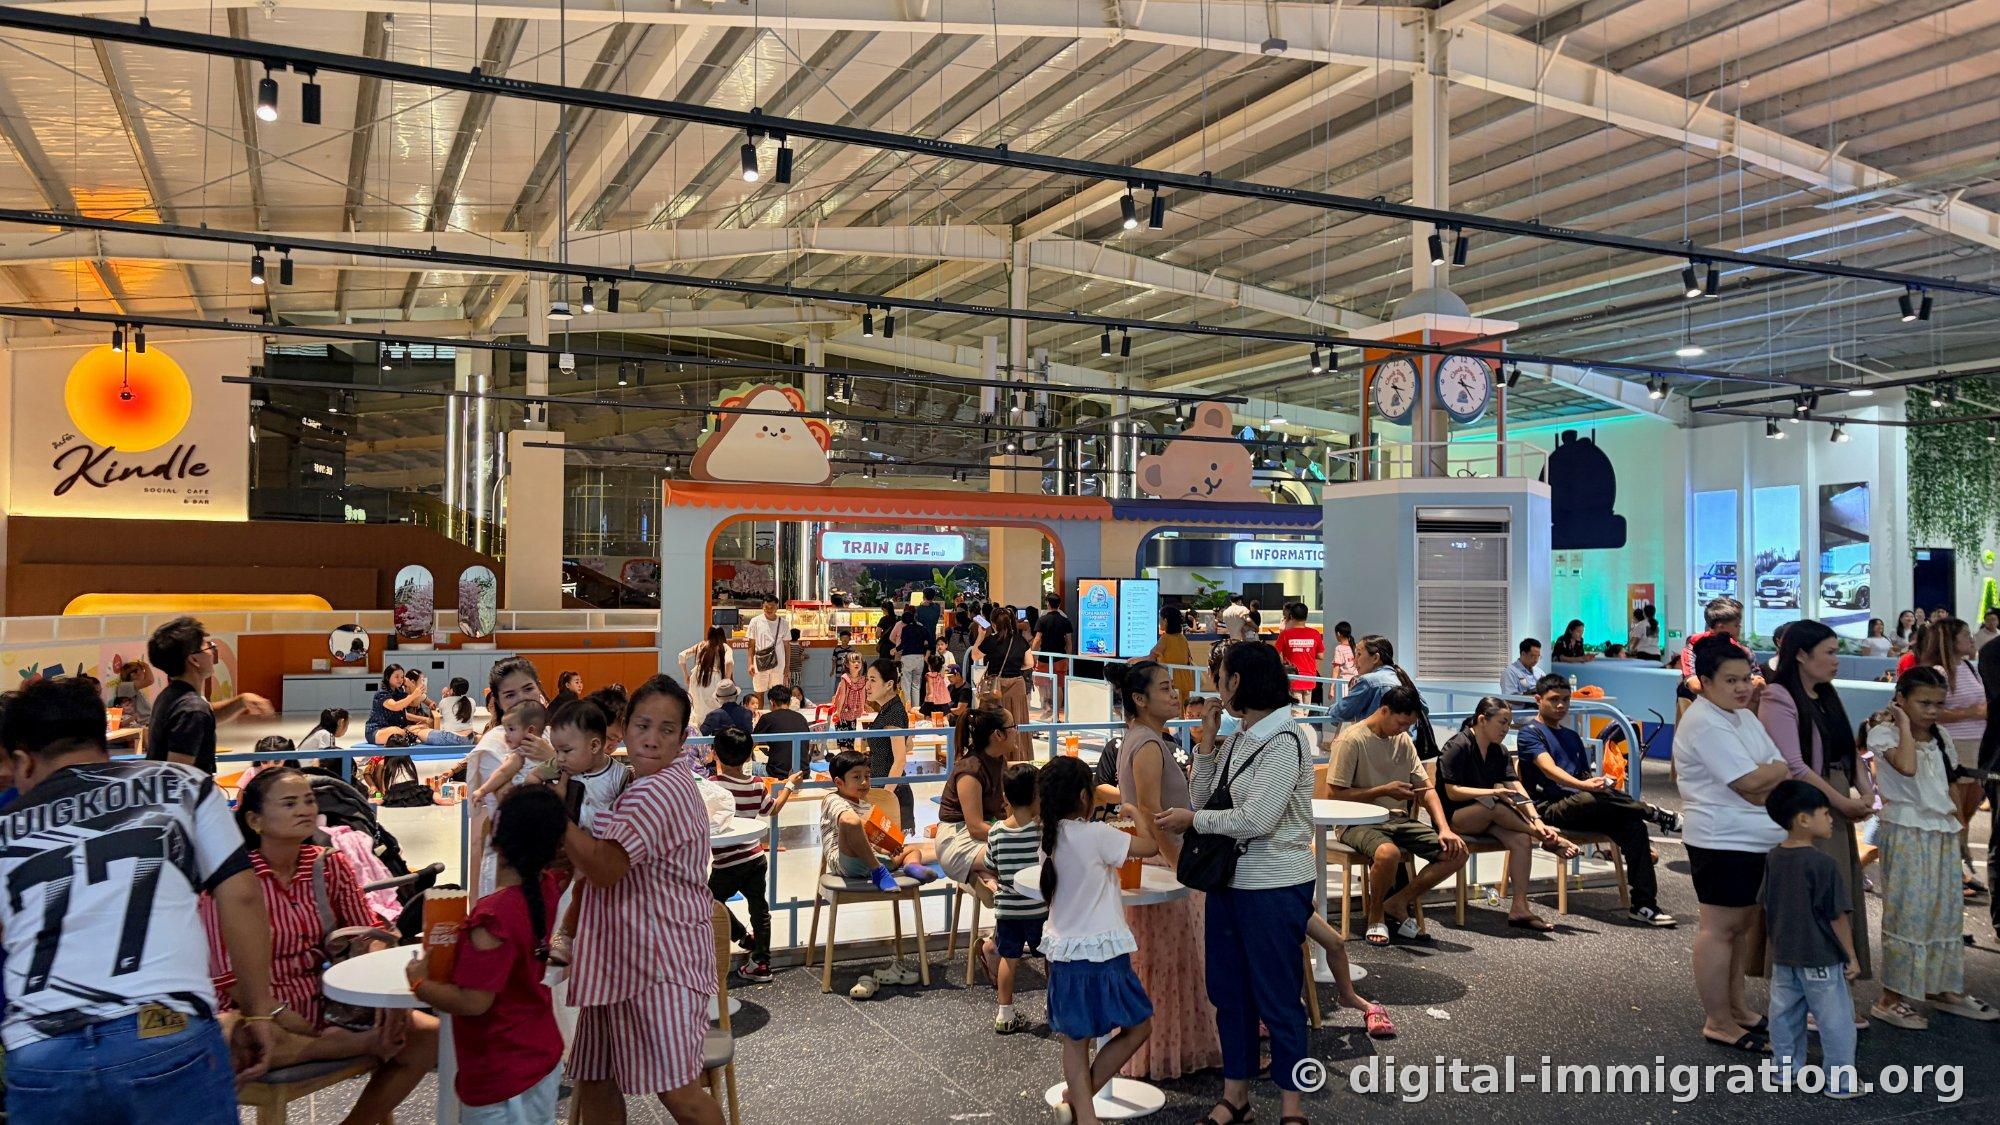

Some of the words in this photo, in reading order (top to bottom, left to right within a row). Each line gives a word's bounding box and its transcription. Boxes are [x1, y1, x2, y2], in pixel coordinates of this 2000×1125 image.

[53, 444, 210, 497] Kindle
[842, 540, 889, 554] TRAIN
[895, 542, 930, 555] CAFE
[1250, 549, 1324, 561] INFORMATIO
[0, 773, 183, 846] UIGKONE
[6, 826, 168, 997] 77
